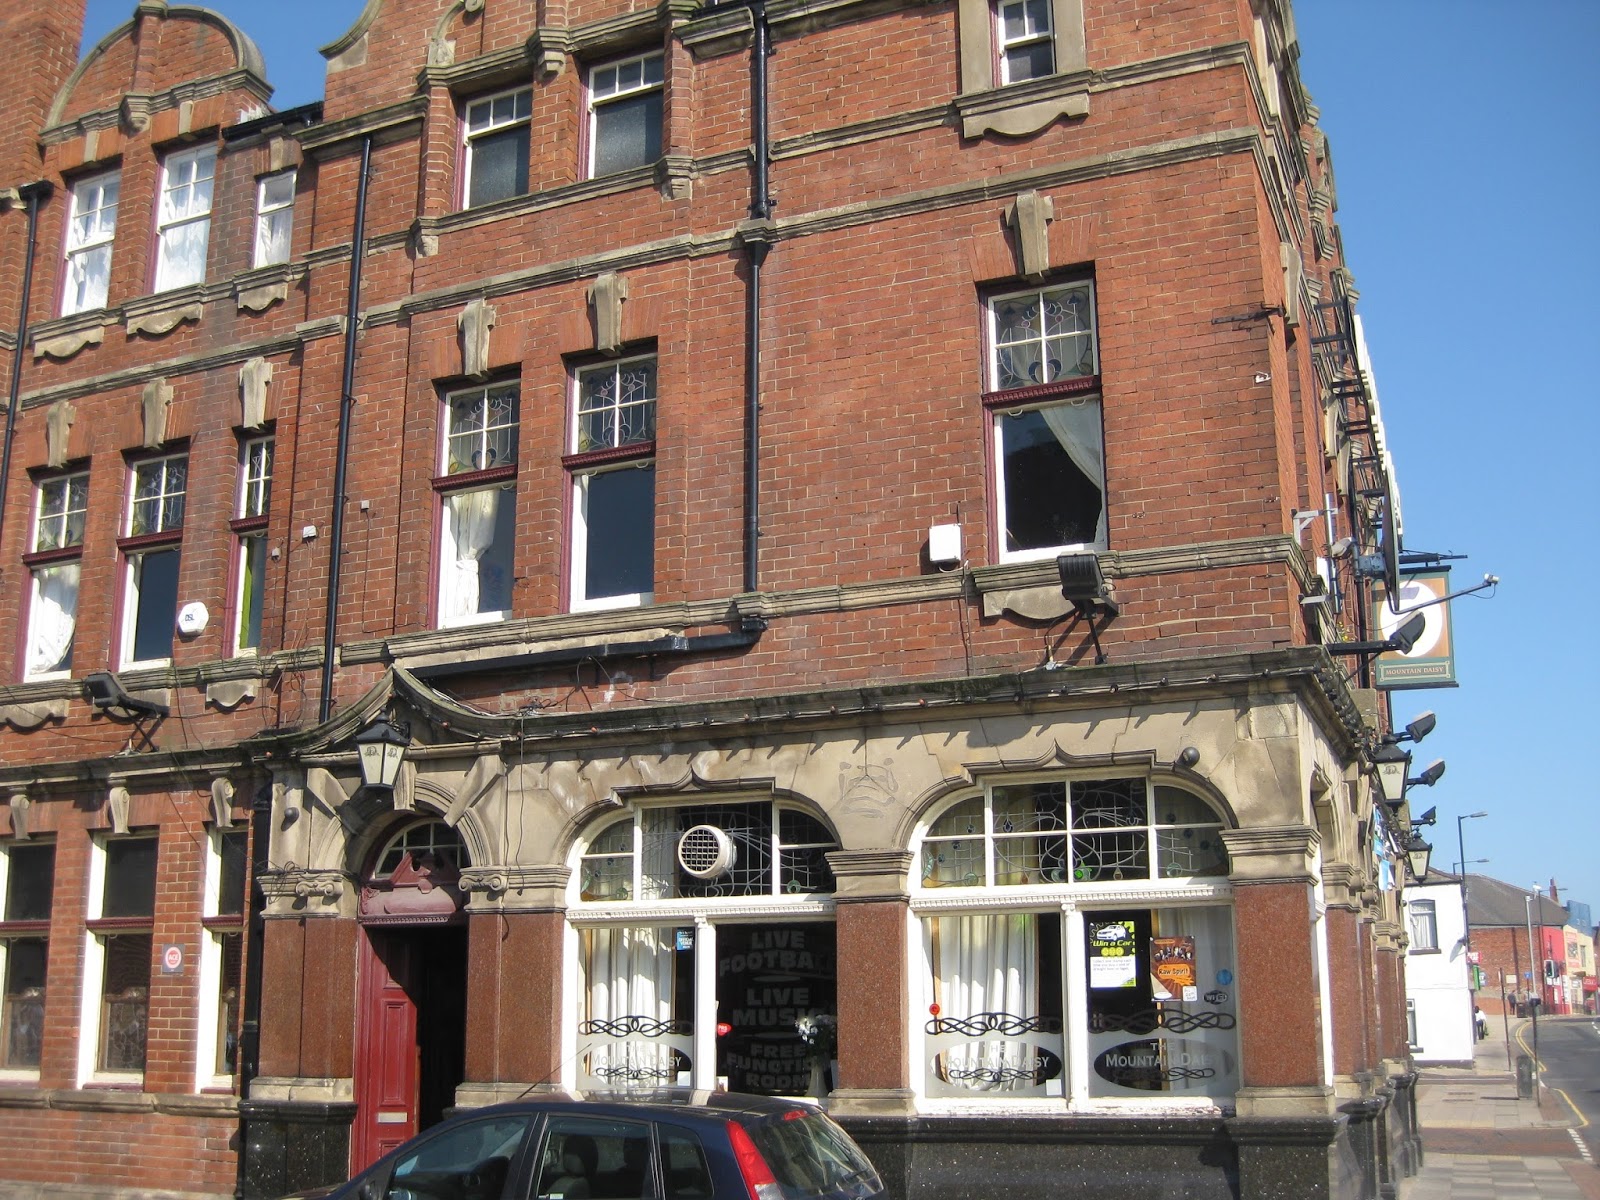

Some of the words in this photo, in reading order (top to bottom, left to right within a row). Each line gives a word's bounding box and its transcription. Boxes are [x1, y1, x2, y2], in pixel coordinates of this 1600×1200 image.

[1386, 667, 1422, 675] MOUNTAIN
[1423, 666, 1444, 674] DAISY
[751, 930, 805, 949] LIVE
[1172, 968, 1188, 976] Spirit
[747, 988, 809, 1006] LIVE
[751, 1044, 806, 1059] FREE
[1150, 1042, 1175, 1051] THE
[726, 1053, 830, 1074] FUNCTIO
[746, 1073, 811, 1089] ROOM
